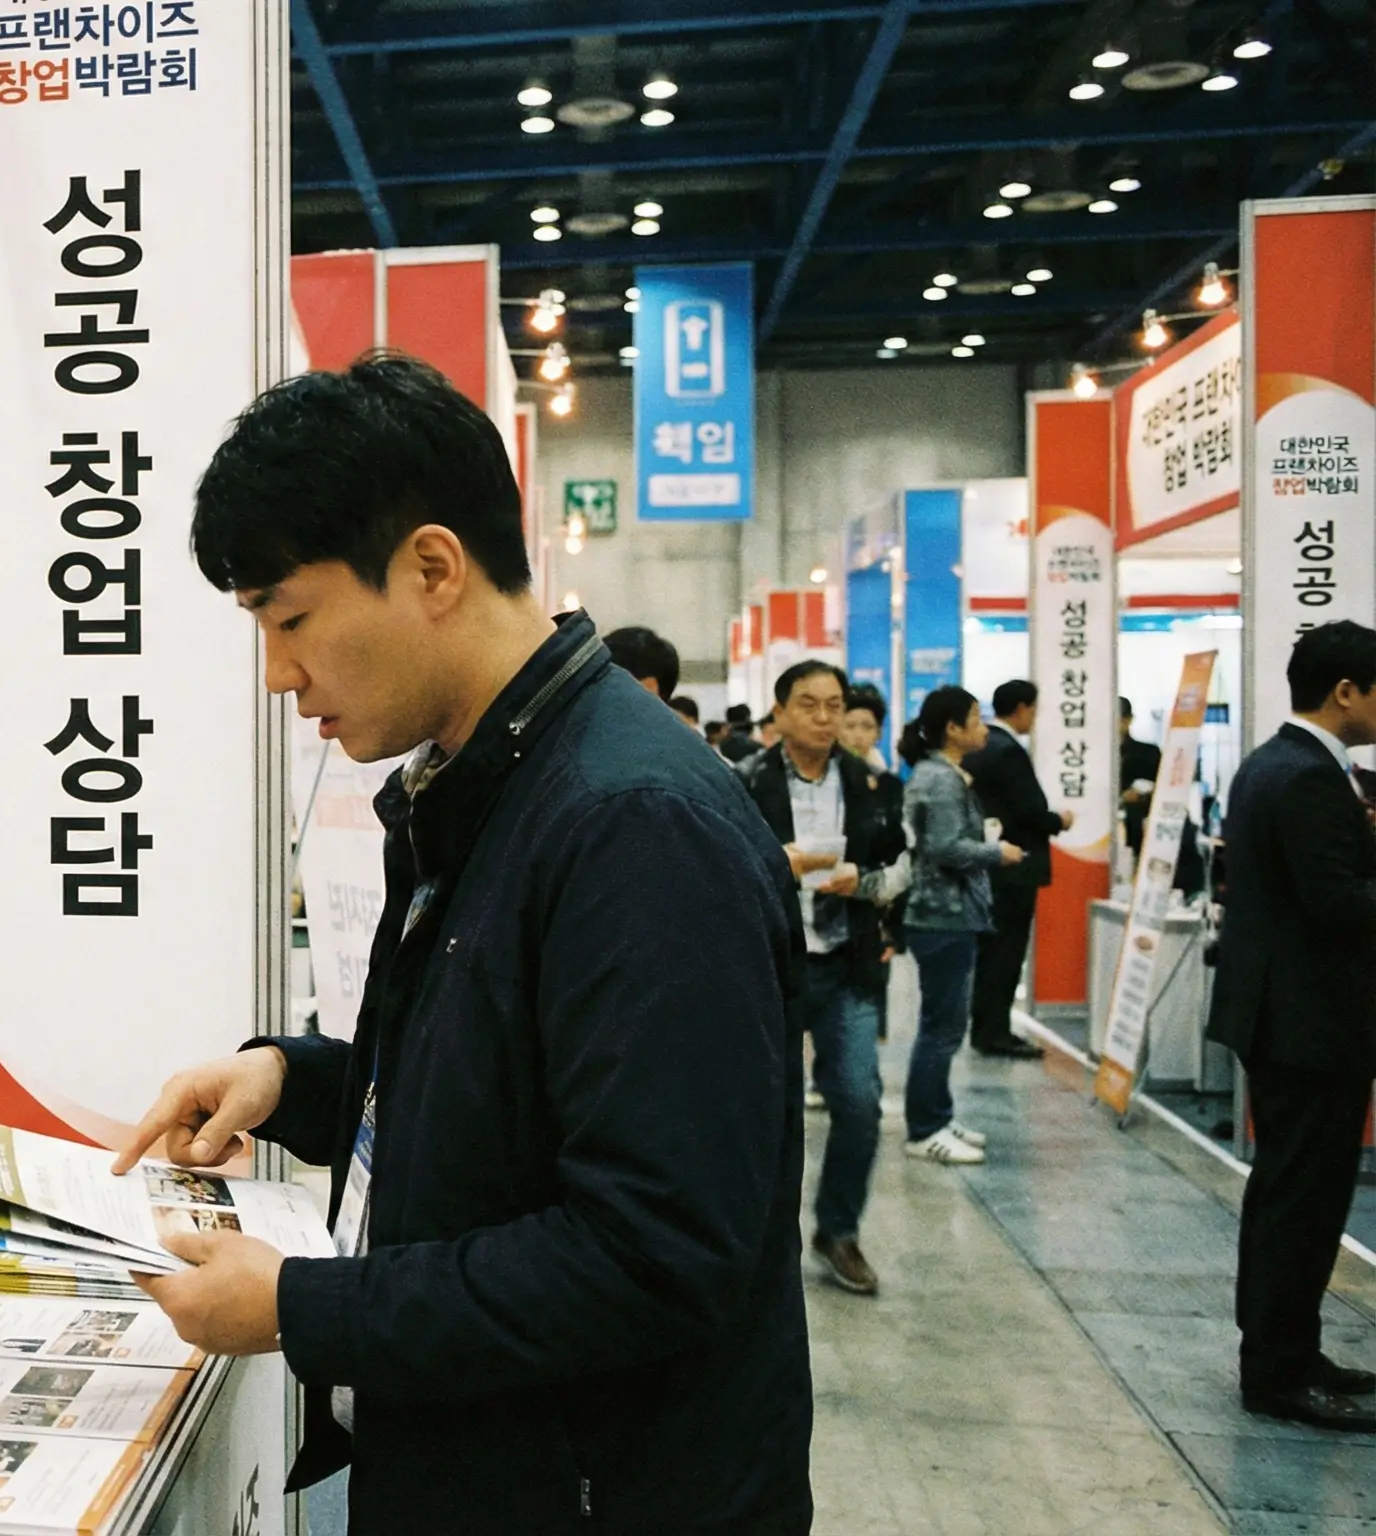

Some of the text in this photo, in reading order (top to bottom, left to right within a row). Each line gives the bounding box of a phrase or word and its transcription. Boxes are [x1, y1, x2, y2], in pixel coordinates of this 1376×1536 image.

[1280, 435, 1350, 455] 대한민국
[42, 169, 154, 917] 성공 창업 상담
[1292, 519, 1337, 607] 성공
[1060, 599, 1088, 659] 성공
[1060, 668, 1088, 729] 창업
[1060, 741, 1089, 798] 상담
